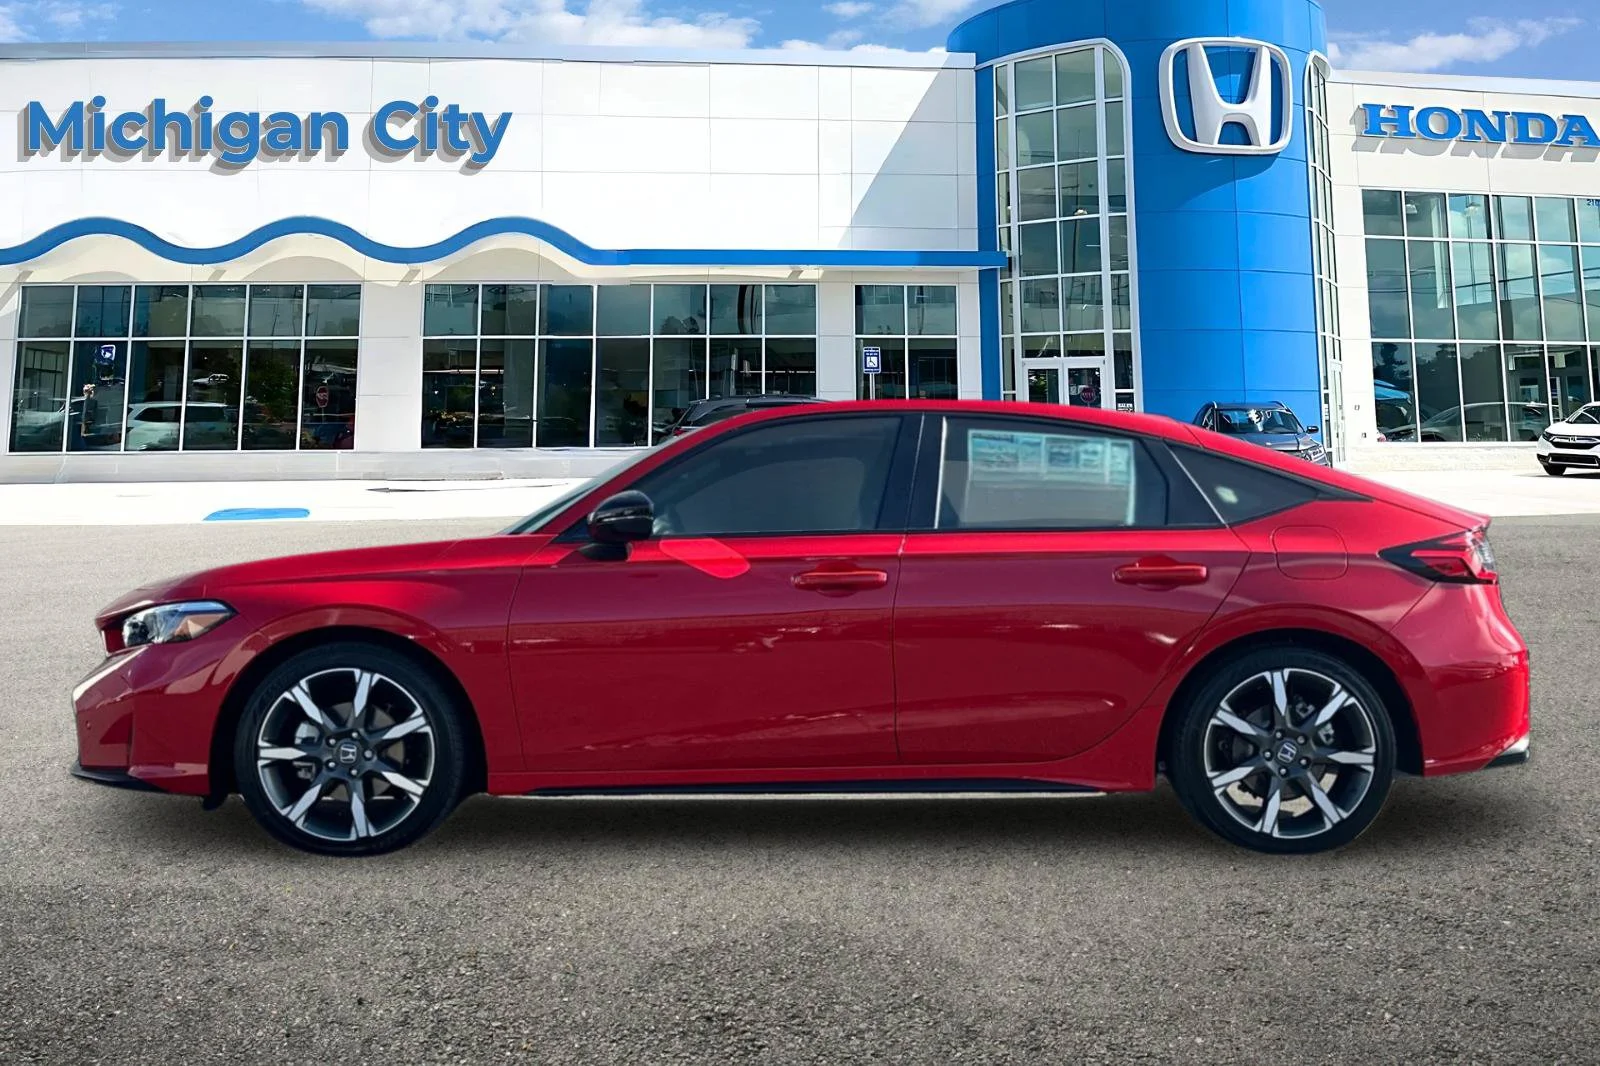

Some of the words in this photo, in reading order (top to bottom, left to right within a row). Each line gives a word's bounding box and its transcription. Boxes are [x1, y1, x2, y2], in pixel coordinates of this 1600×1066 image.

[28, 95, 349, 164] Michigan
[373, 95, 513, 165] City
[1361, 103, 1600, 147] HONDA
